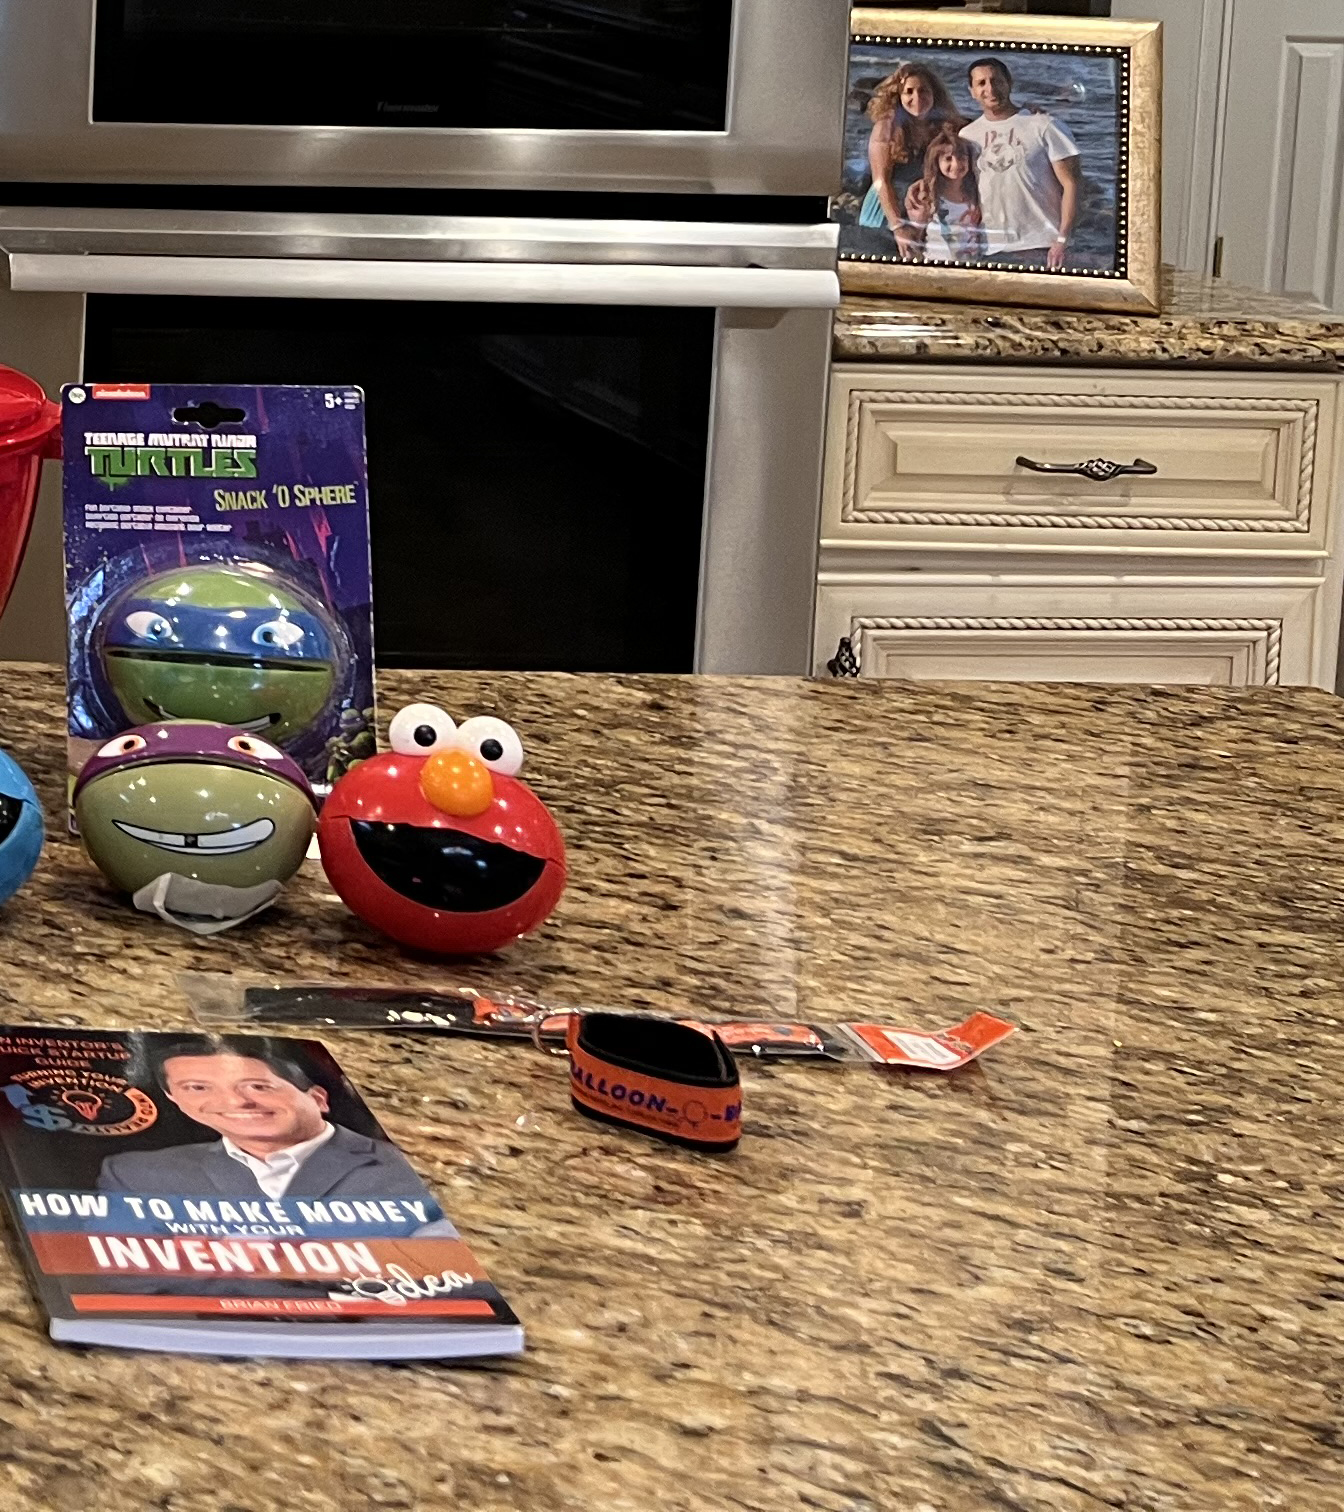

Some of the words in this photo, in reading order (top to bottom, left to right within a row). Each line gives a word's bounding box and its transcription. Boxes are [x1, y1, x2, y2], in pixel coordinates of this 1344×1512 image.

[324, 393, 343, 409] 5+
[84, 432, 145, 447] TEENAGE
[148, 433, 209, 448] MUTANT
[211, 434, 257, 448] NINJA
[85, 447, 258, 478] TURTLES
[15, 1037, 125, 1051] INVENTOR'S
[34, 1056, 91, 1068] GUIDE
[48, 1047, 131, 1061] STARTUP
[26, 1075, 124, 1093] INVENTION
[19, 1192, 108, 1218] HOW
[124, 1197, 174, 1222] TO
[182, 1199, 291, 1225] MAKE
[301, 1199, 429, 1224] MONEY
[166, 1221, 233, 1235] WITH
[234, 1223, 306, 1237] YOUR
[88, 1236, 380, 1275] INVENTION
[218, 1298, 279, 1312] BRIAN
[281, 1299, 343, 1313] FRIED
